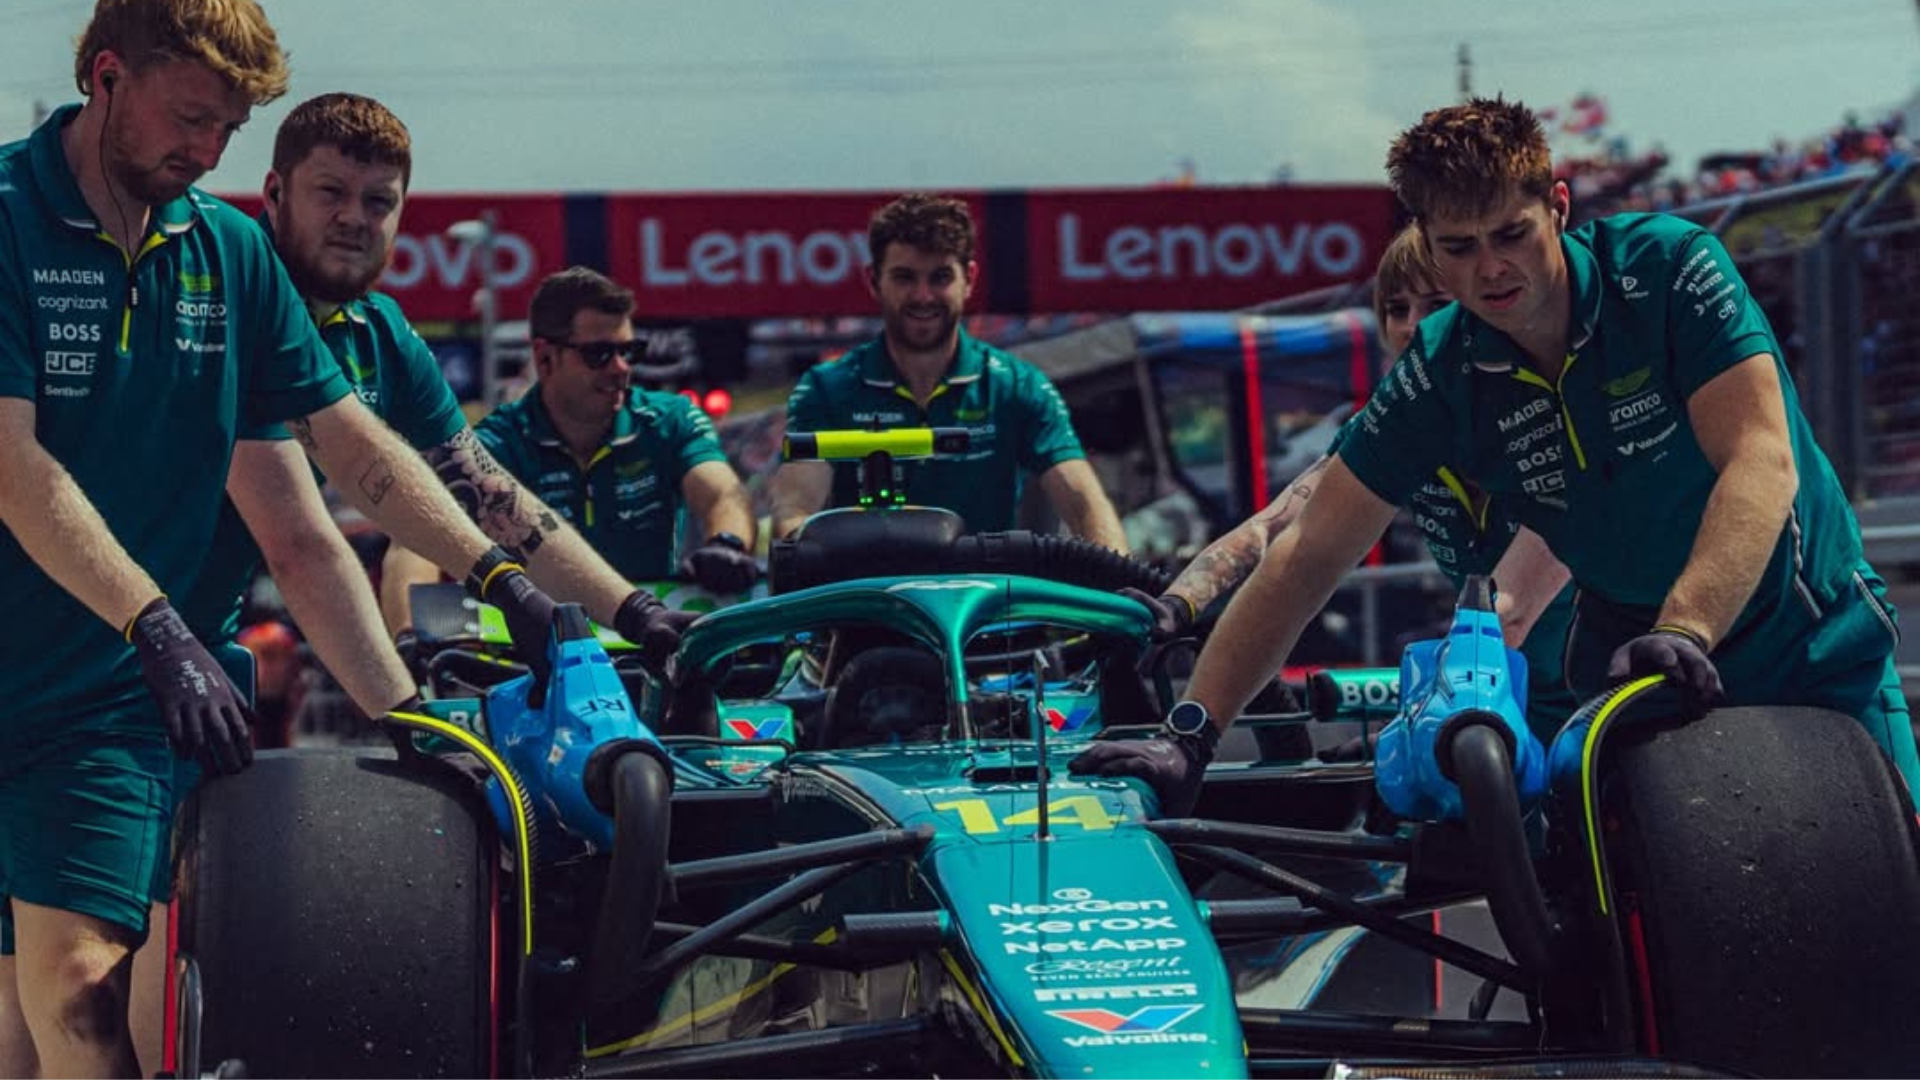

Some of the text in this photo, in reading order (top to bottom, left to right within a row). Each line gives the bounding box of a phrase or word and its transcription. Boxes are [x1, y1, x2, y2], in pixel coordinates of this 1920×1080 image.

[1059, 213, 1363, 279] Lenovo
[33, 269, 105, 285] MAADEN
[49, 322, 101, 342] BOSS
[934, 795, 1128, 835] 14
[988, 899, 1169, 916] NexGen
[999, 916, 1178, 935] xerox
[1004, 938, 1187, 954] NetApp
[1034, 984, 1197, 1001] PIRELLI
[1063, 1032, 1208, 1047] Valvoline
